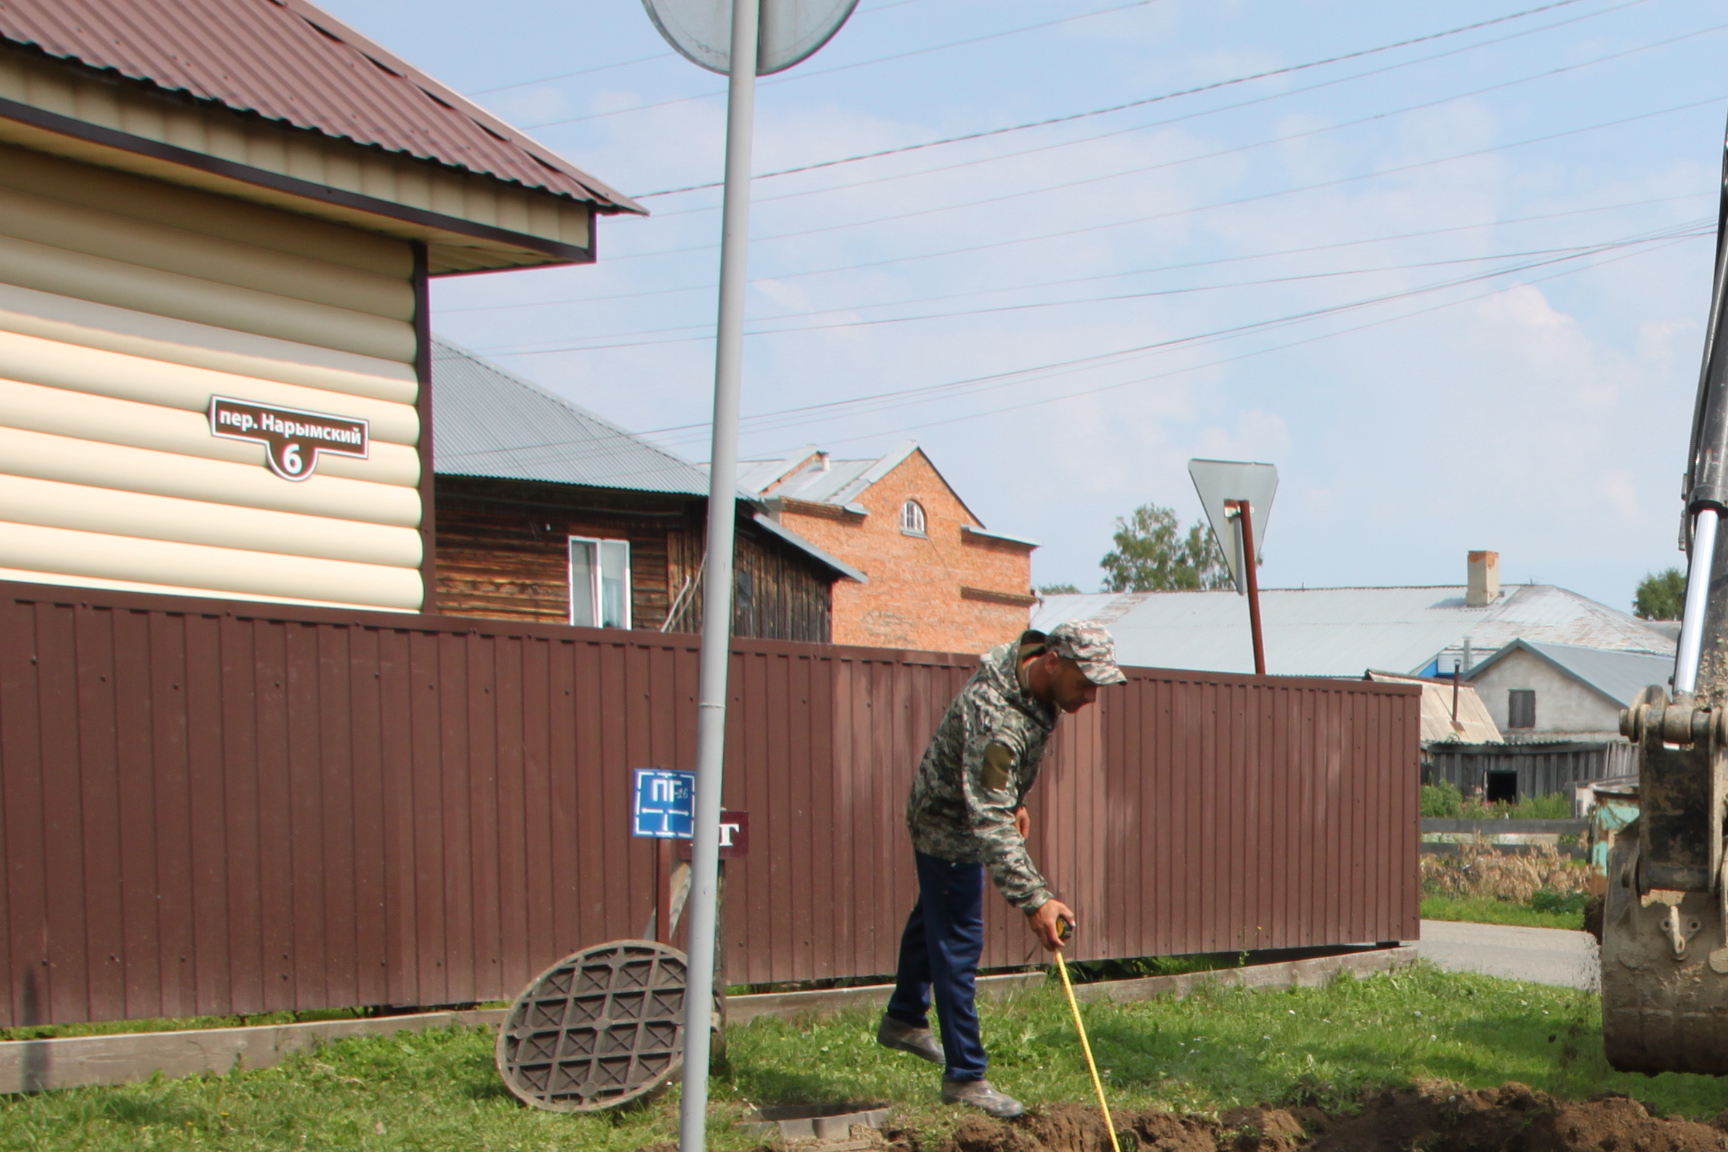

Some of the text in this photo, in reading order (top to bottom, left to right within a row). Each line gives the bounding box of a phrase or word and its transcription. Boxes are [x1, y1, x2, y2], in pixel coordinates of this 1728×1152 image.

[219, 410, 362, 445] пер. Нарымский
[283, 443, 303, 475] 6
